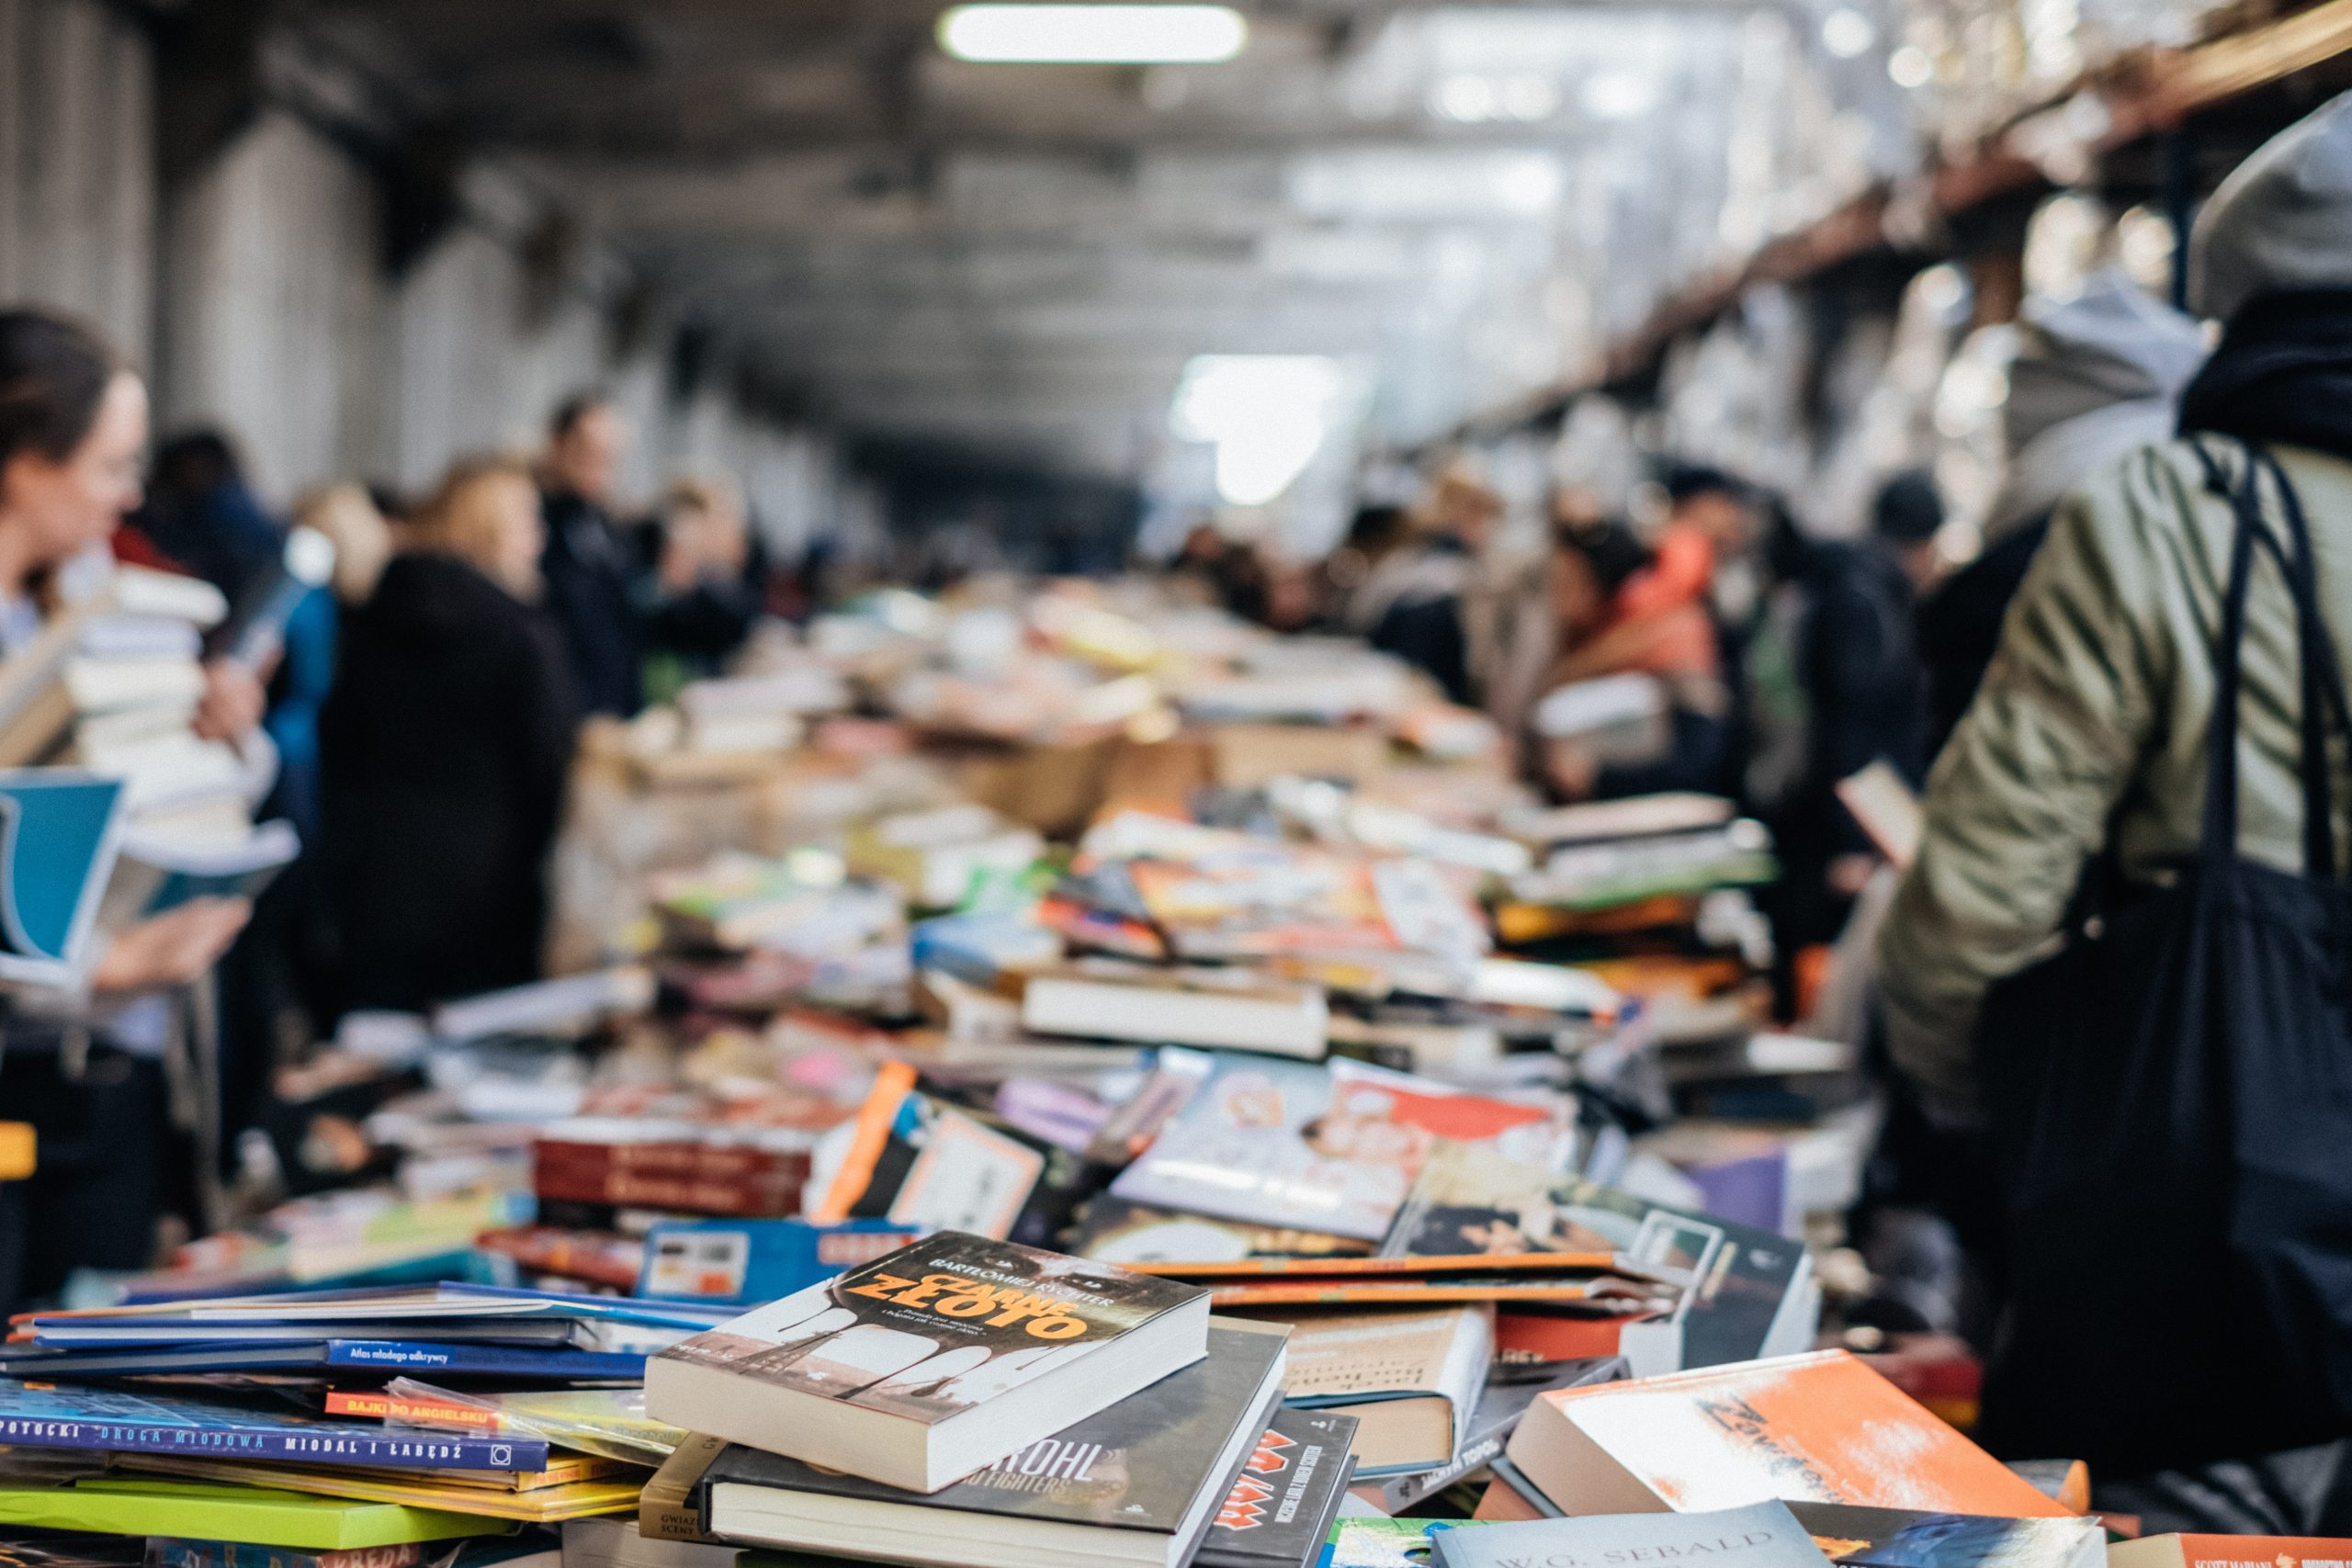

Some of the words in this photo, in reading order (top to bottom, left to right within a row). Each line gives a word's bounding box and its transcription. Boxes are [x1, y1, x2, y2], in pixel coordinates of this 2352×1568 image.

[921, 1274, 1080, 1316] CZARNE
[928, 1258, 1036, 1287] BARTŁOMIEJ
[1035, 1283, 1115, 1307] RYCHTER
[845, 1273, 1088, 1339] ZŁOTO
[350, 1348, 371, 1359] Atlas
[372, 1348, 408, 1363] młodego
[409, 1351, 449, 1365] odkrywcy
[347, 1400, 387, 1414] BAJKI
[390, 1402, 409, 1416] PO
[412, 1405, 489, 1423] ANGIELSKU
[101, 1427, 160, 1442] DROGA
[175, 1430, 264, 1449] MIODOWA
[285, 1438, 357, 1454] MIODAL
[370, 1442, 377, 1454] I
[390, 1440, 461, 1460] ŁABĘDŹ
[989, 1438, 1102, 1482] OHL
[983, 1471, 1072, 1494] FIGHTERS
[661, 1514, 700, 1525] GWIAZ
[661, 1525, 695, 1536] SCENY
[1603, 1531, 1773, 1563] SEBALD
